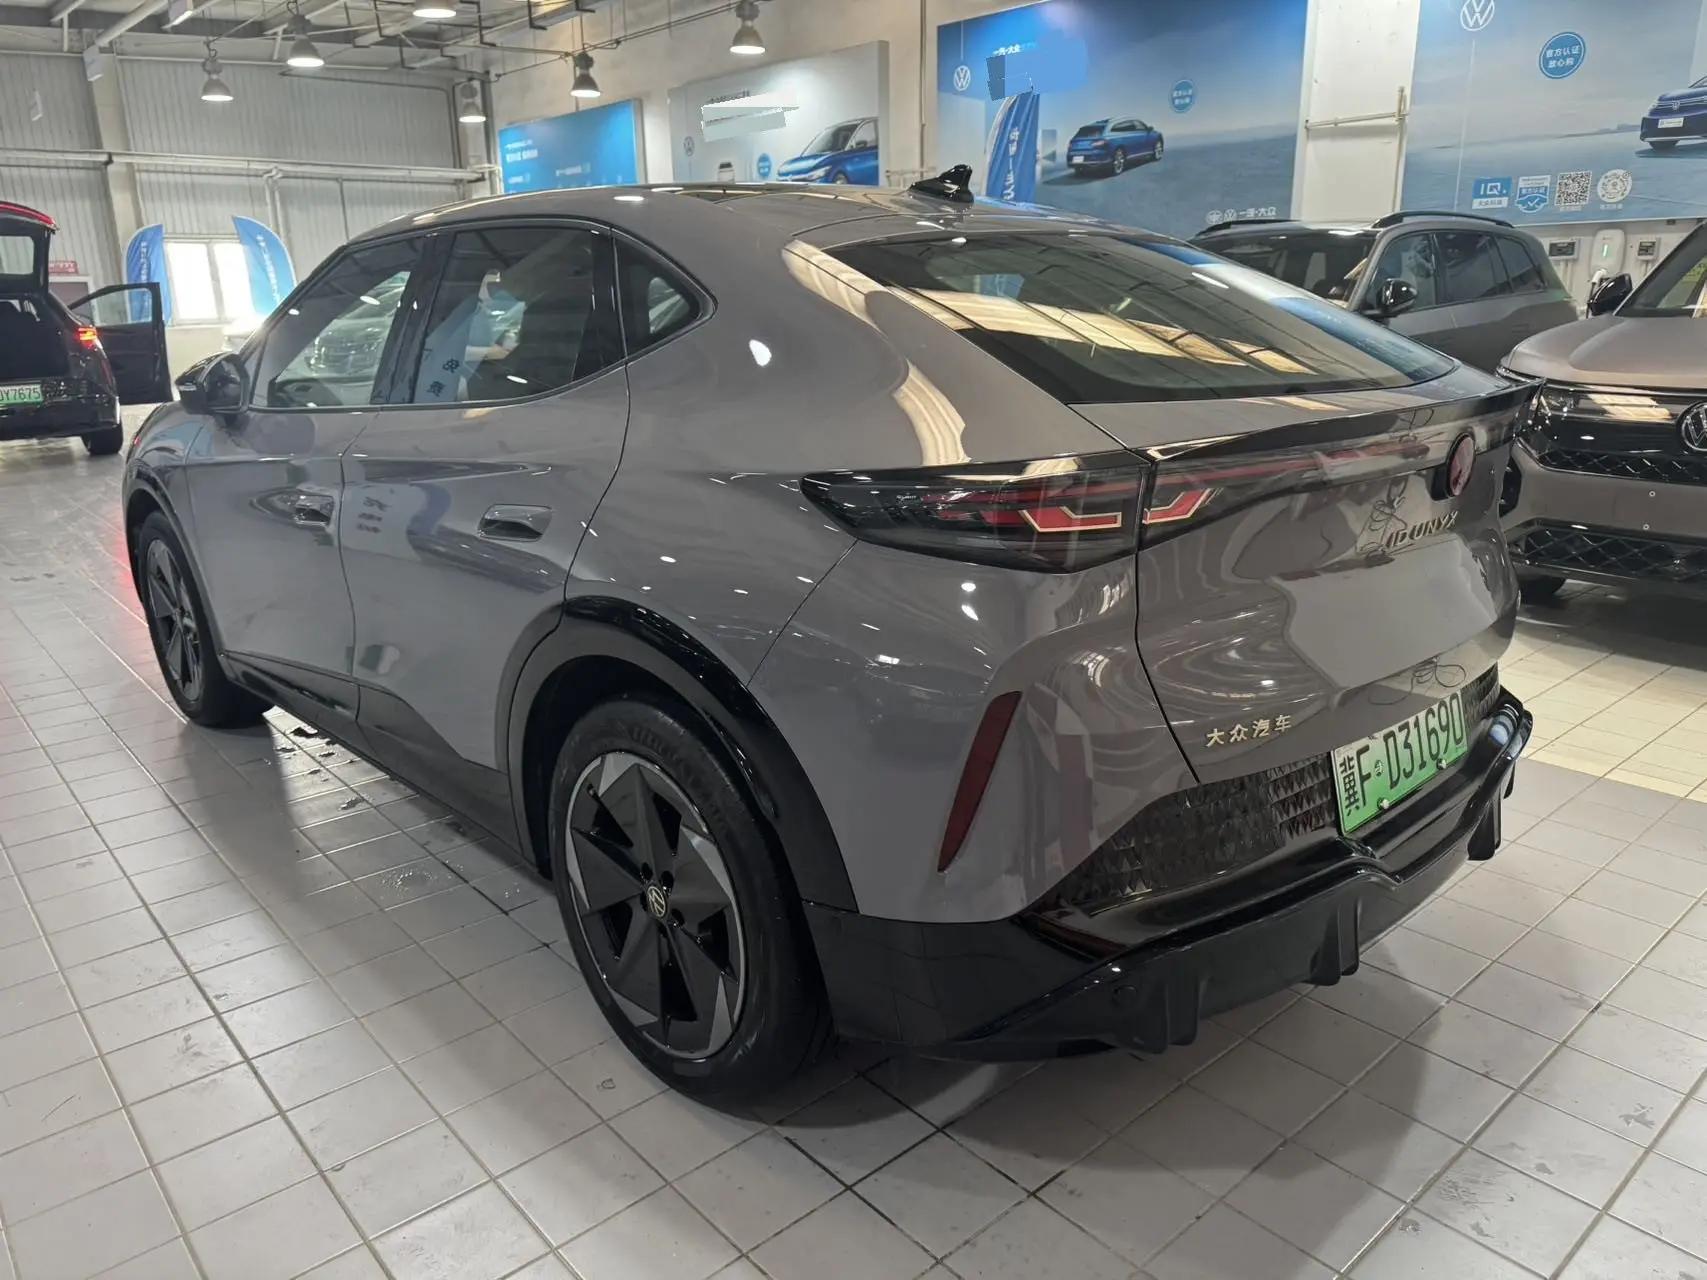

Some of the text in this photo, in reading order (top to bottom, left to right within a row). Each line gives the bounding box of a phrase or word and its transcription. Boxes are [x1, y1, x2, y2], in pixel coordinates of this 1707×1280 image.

[0, 387, 41, 401] Y7675
[1206, 715, 1292, 748] 大众汽车
